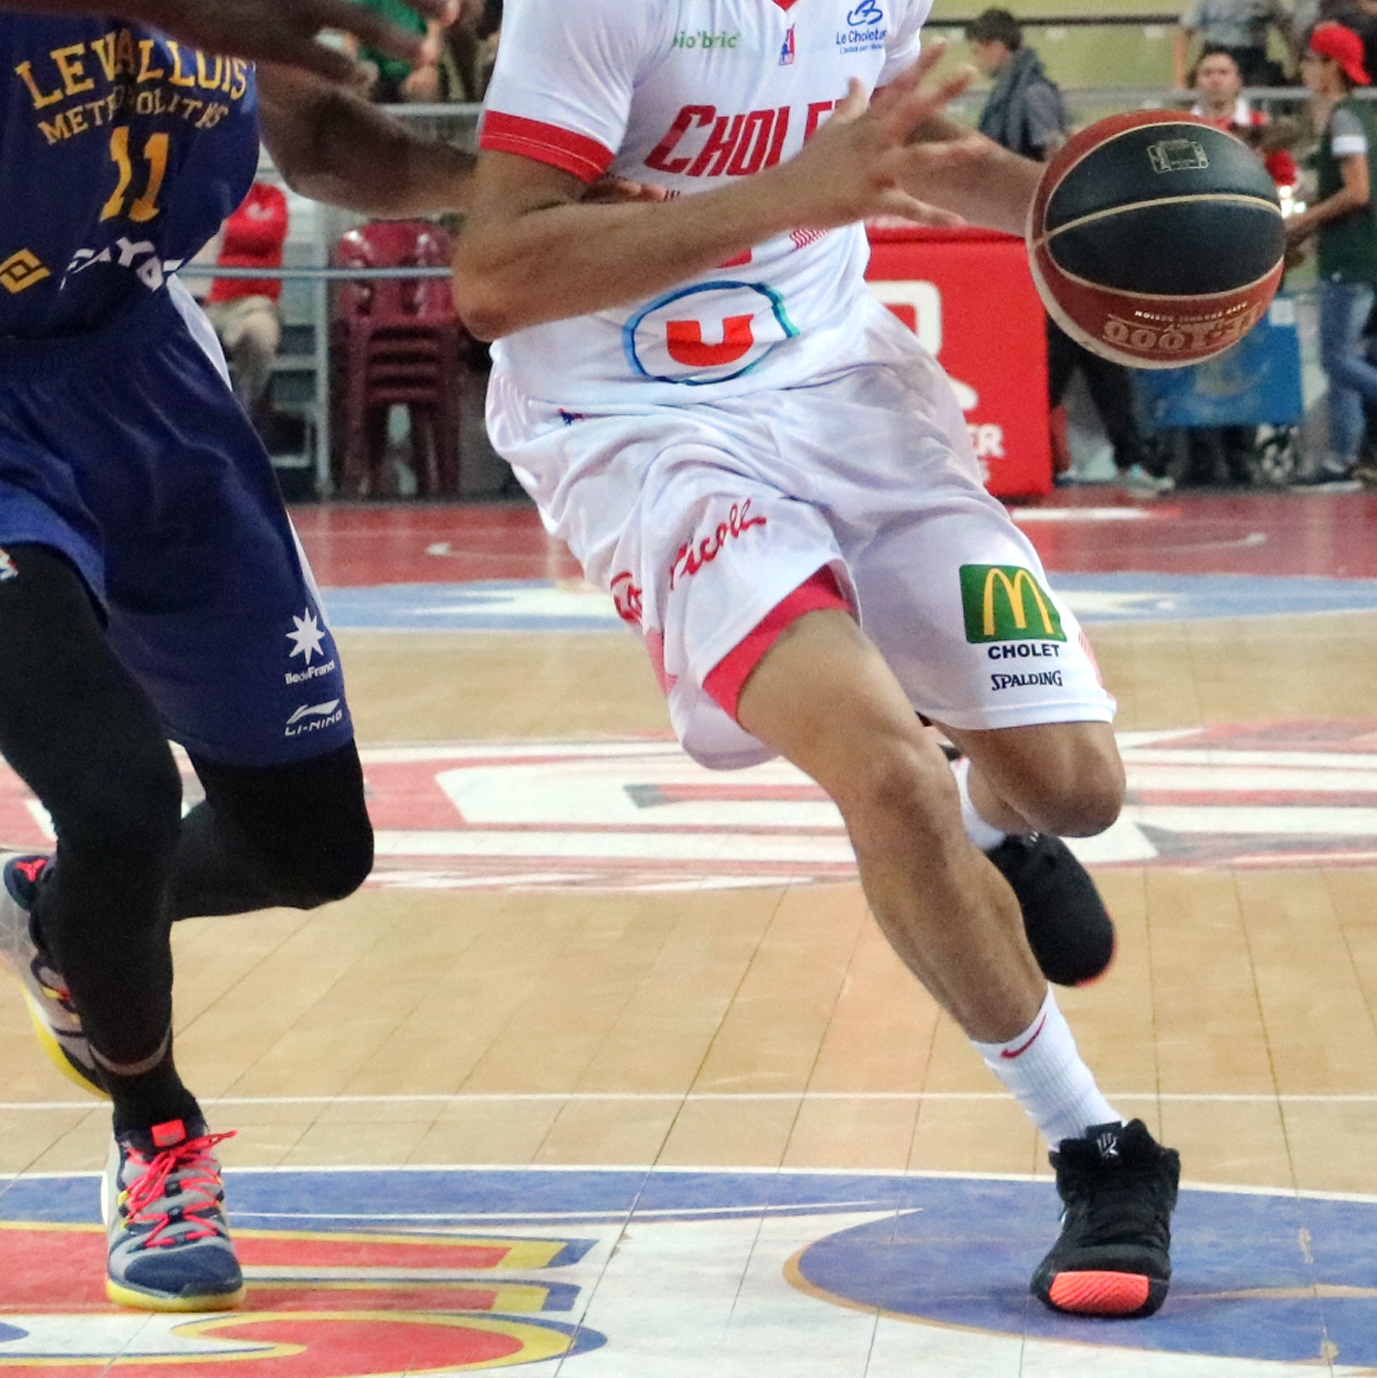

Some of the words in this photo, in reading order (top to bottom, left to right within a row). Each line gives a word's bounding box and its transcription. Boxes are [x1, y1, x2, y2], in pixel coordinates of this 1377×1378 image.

[644, 97, 848, 178] CHOLE
[99, 125, 170, 223] 11
[666, 313, 755, 367] U
[988, 644, 1060, 660] CHOLET
[991, 670, 1064, 692] SPALDING
